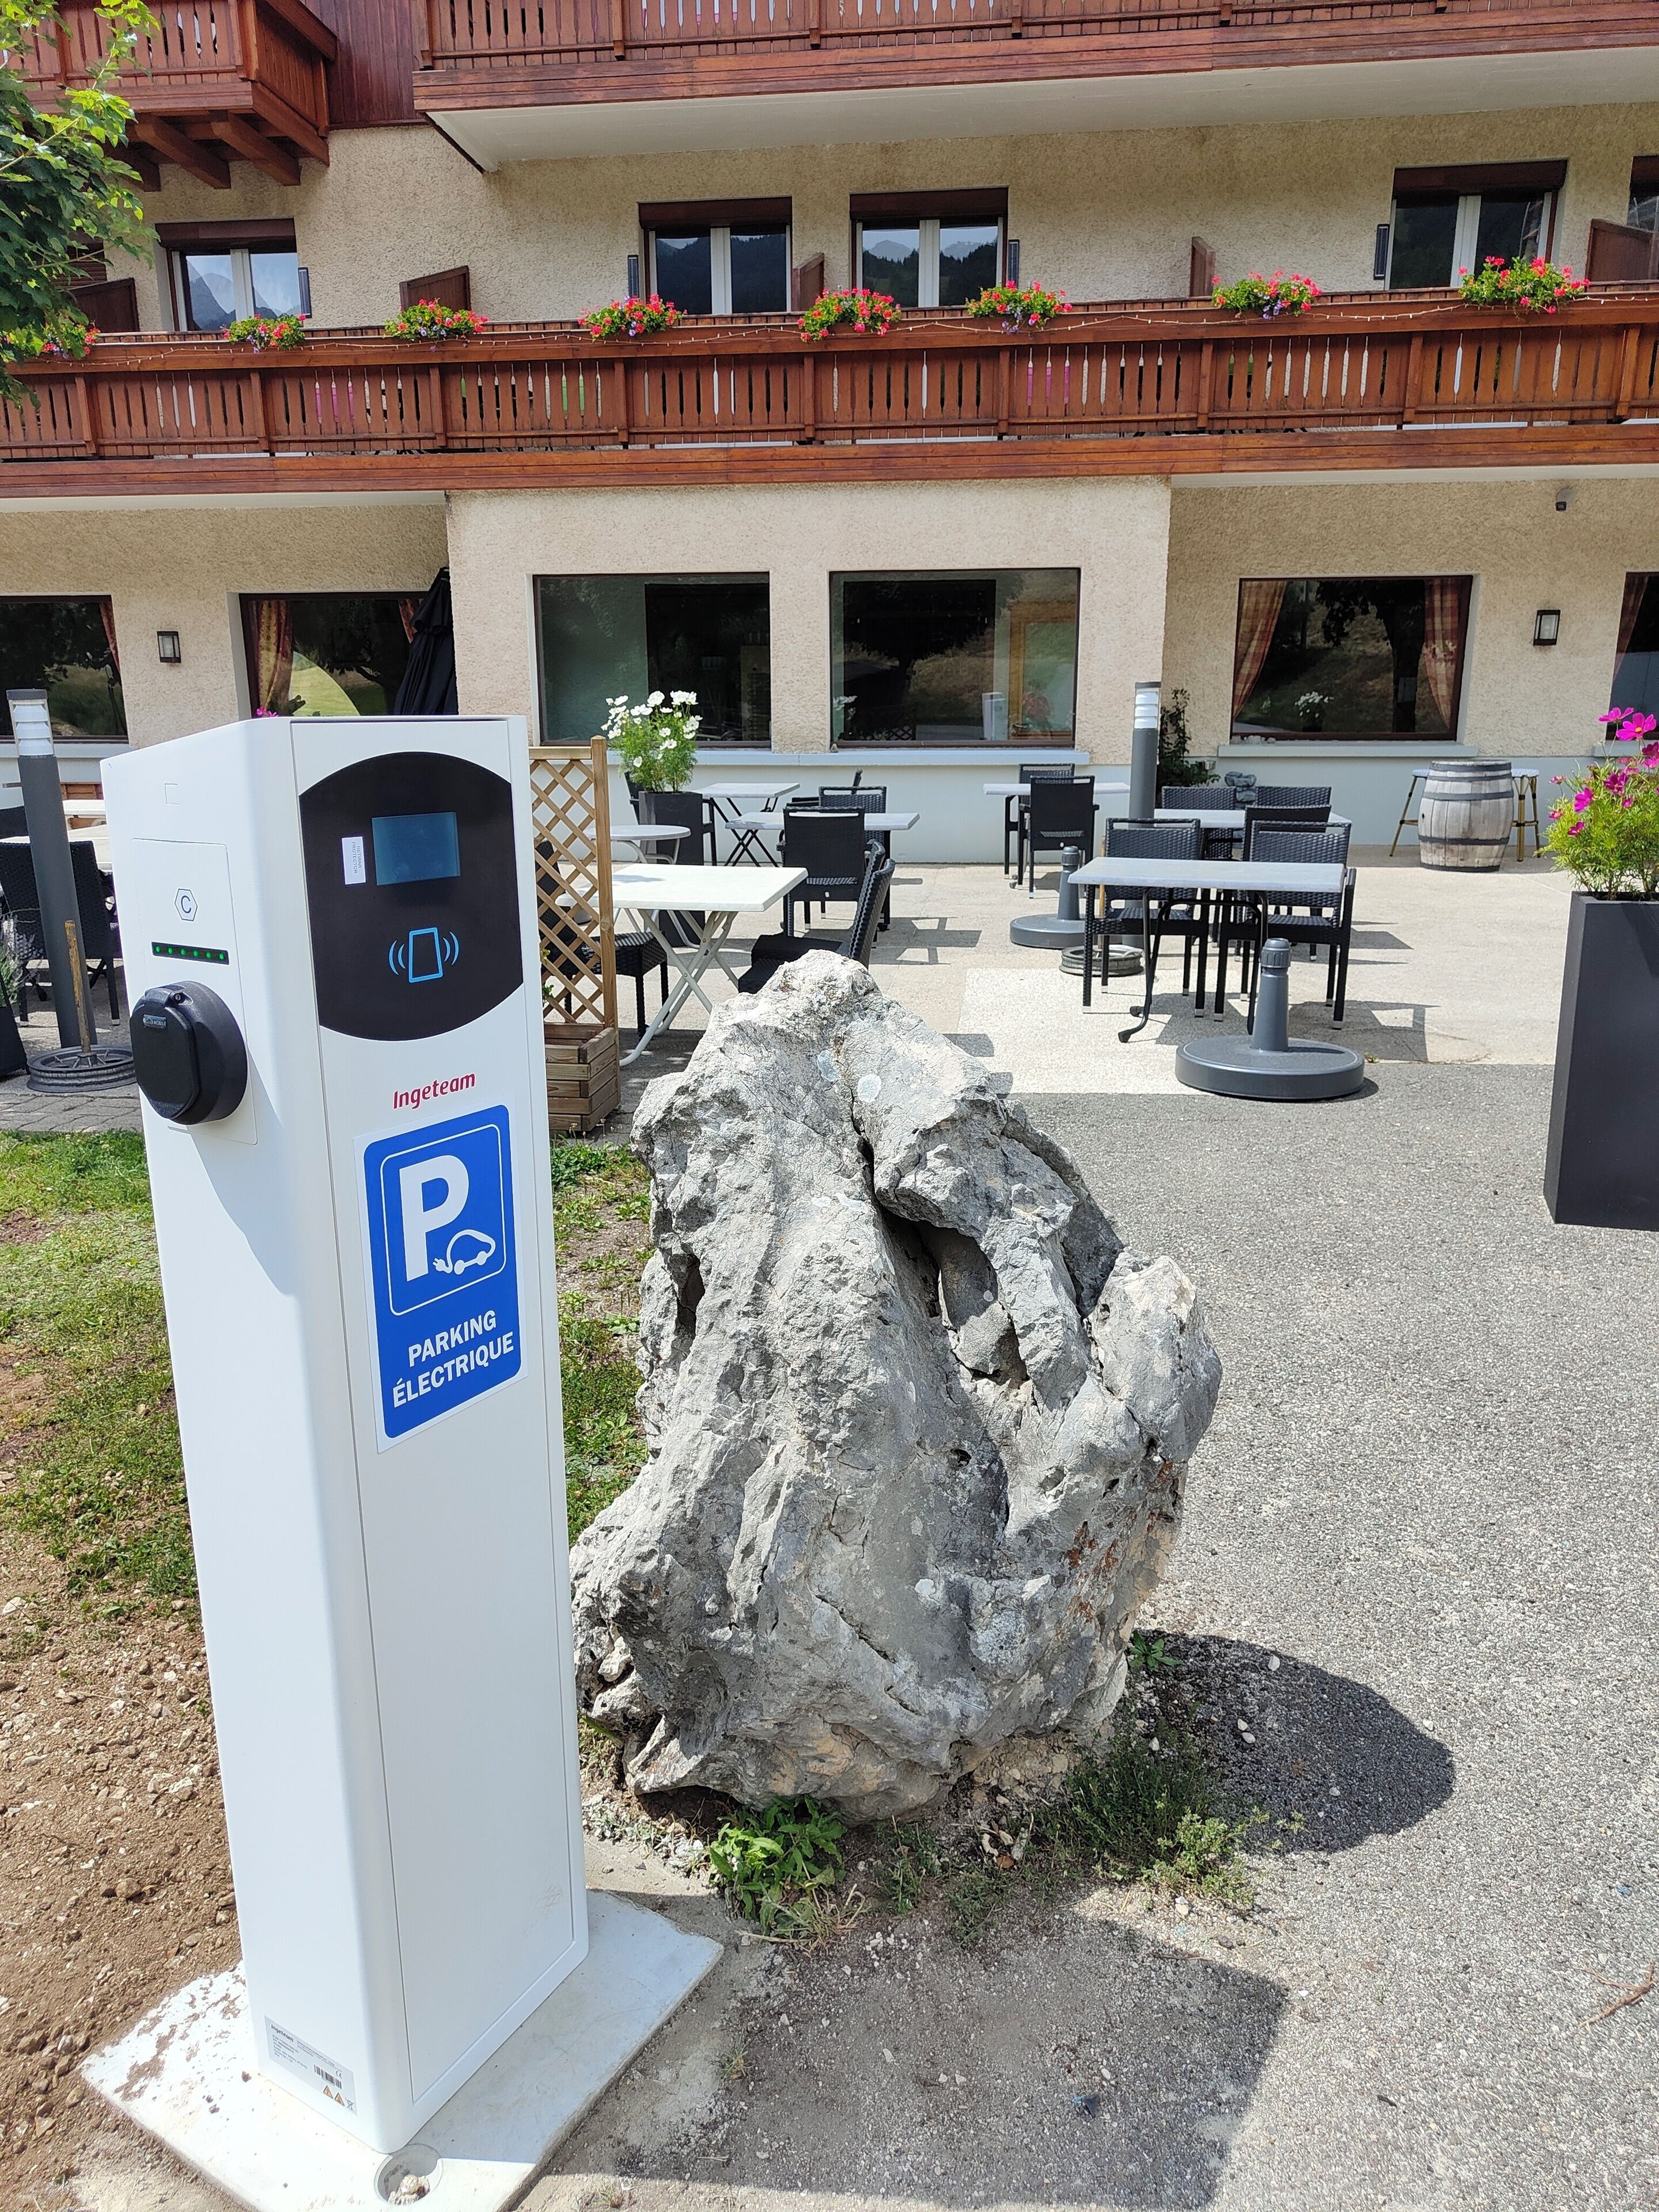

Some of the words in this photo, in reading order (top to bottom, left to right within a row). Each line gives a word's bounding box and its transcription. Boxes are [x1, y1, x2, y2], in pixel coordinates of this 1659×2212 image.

[181, 895, 191, 914] C
[393, 1073, 475, 1109] Ingeteam
[399, 1155, 469, 1282] P
[408, 1310, 497, 1368] PARKING
[393, 1331, 514, 1408] ÉLECTRIQUE
[271, 2024, 294, 2043] Ingeteam
